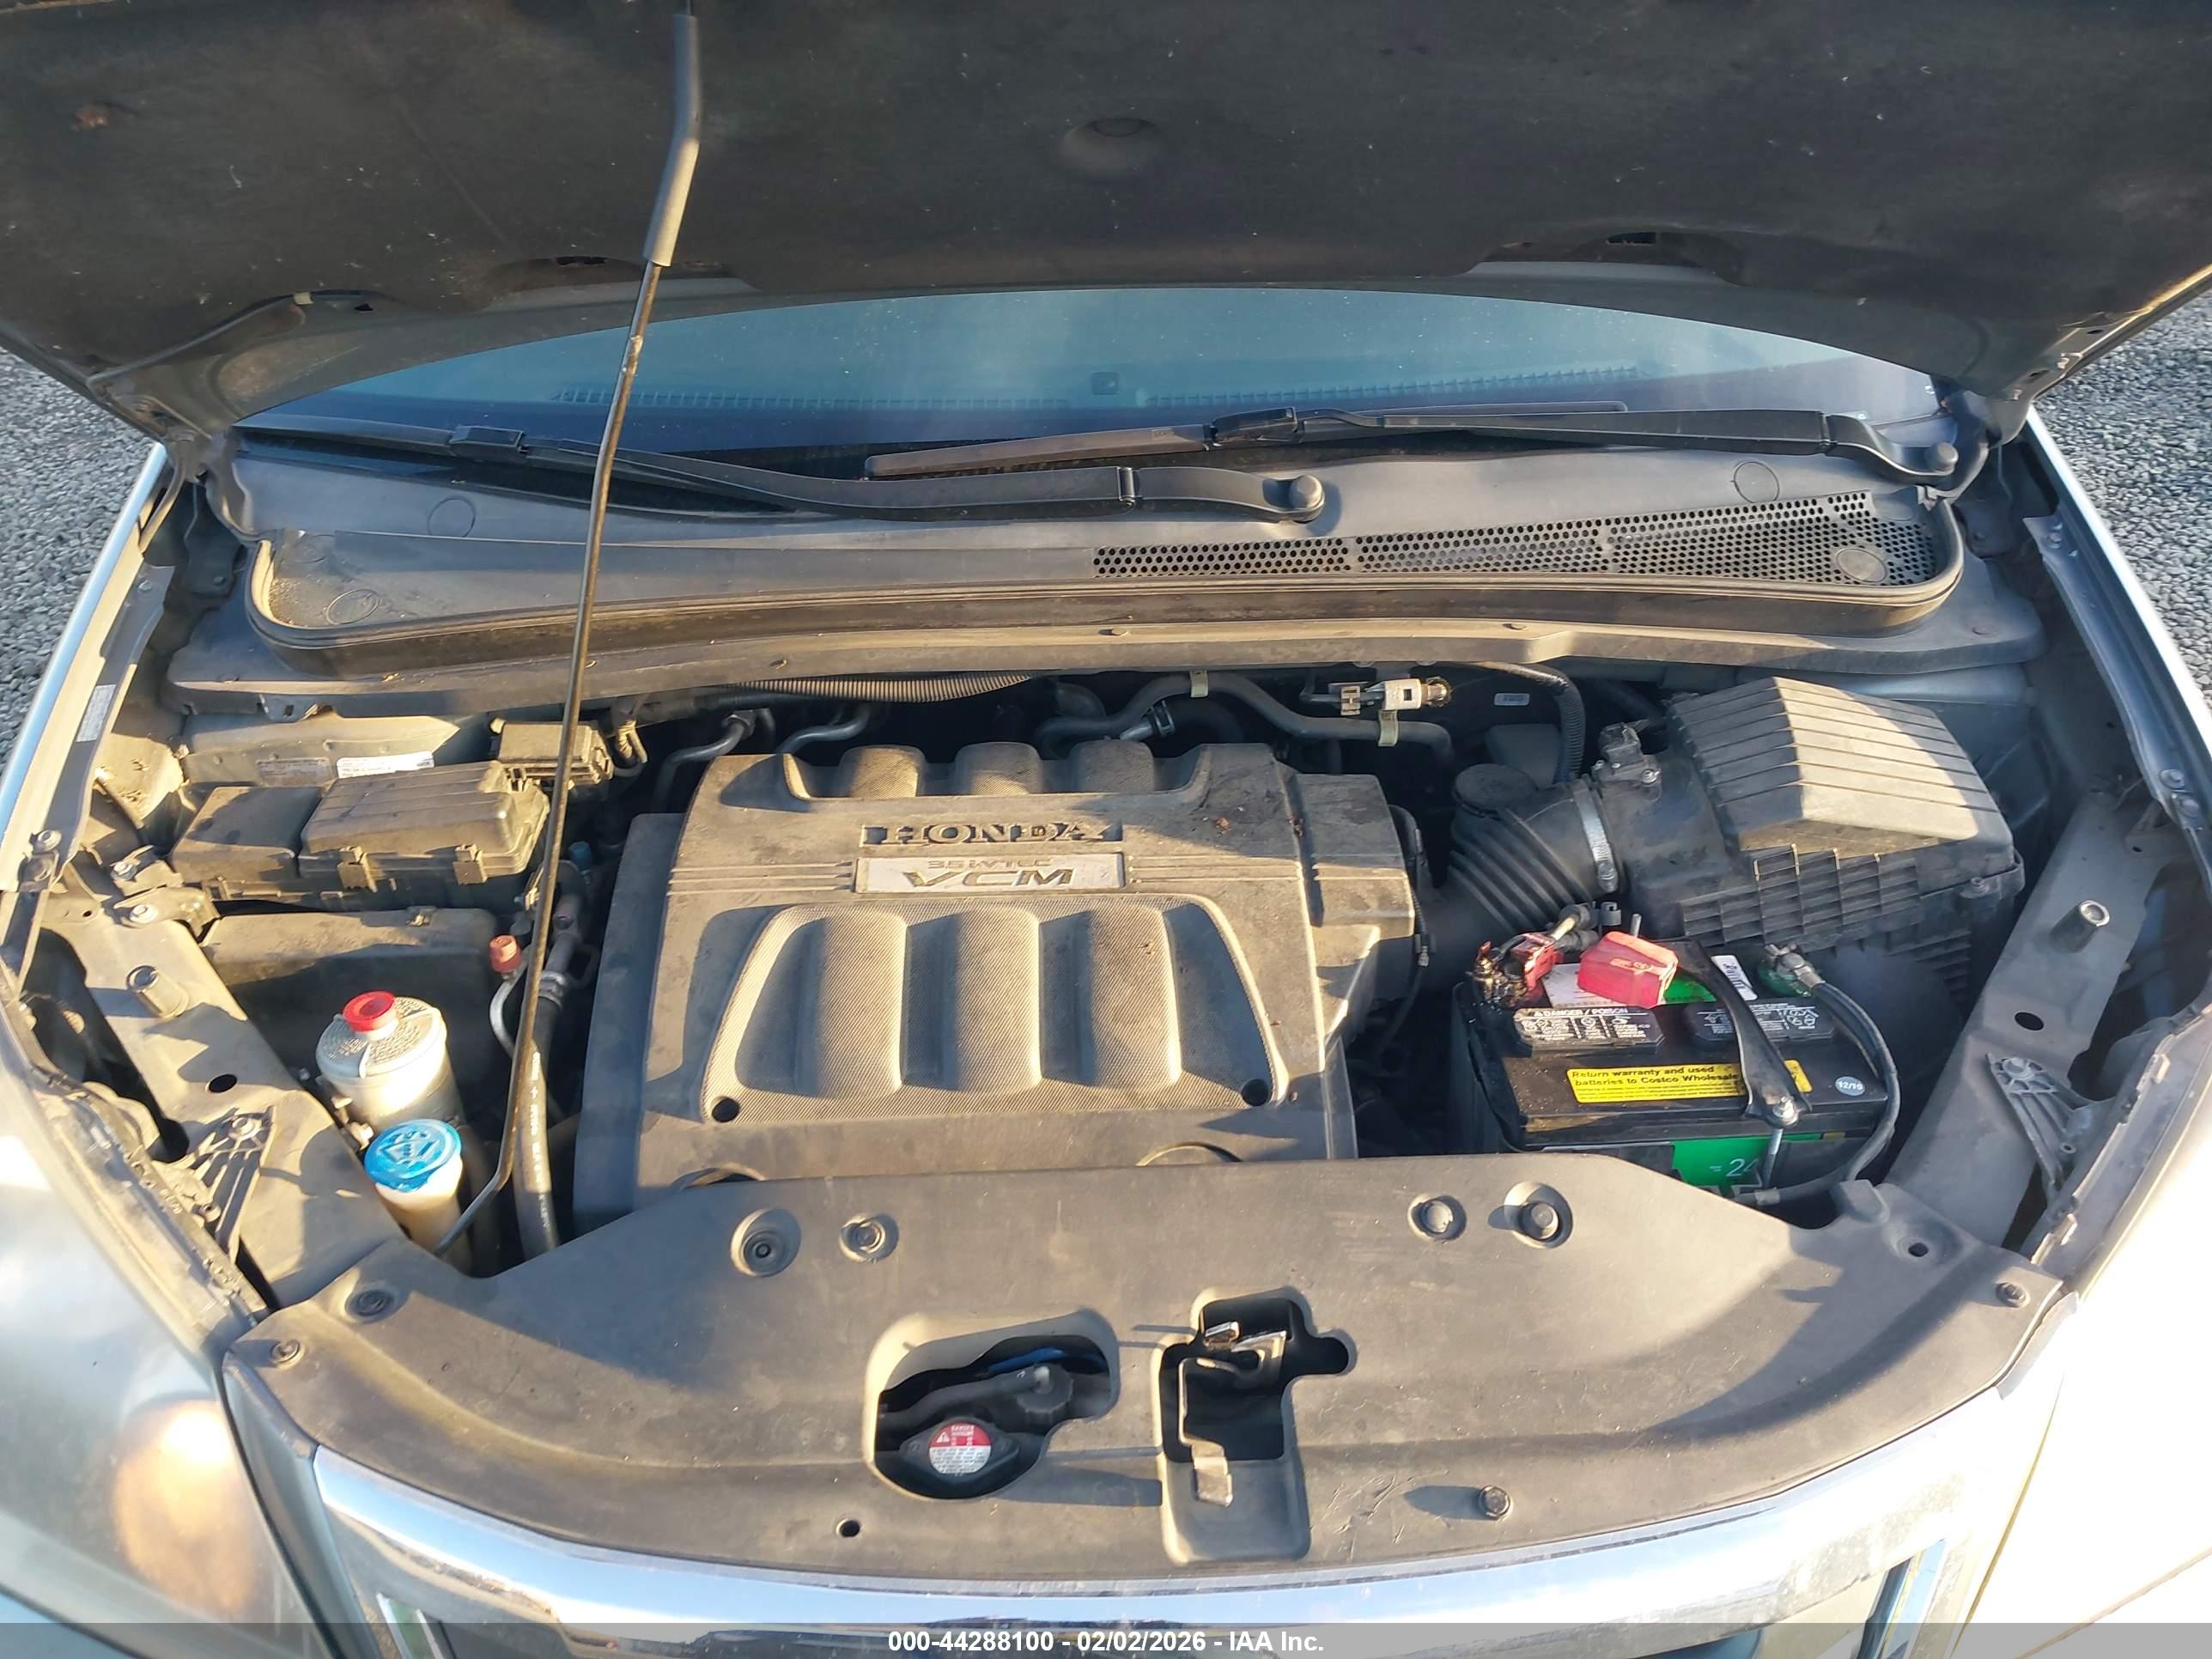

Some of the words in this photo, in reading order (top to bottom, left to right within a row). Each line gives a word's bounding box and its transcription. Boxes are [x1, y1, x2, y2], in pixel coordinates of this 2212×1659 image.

[881, 822, 1110, 846] HONDA
[903, 868, 1074, 888] VCM
[1575, 1078, 1624, 1086] batteries
[1640, 1076, 1679, 1085] Costco
[1682, 1073, 1740, 1082] Wholesale
[1613, 1068, 1662, 1079] warranty
[1664, 1066, 1684, 1075] and
